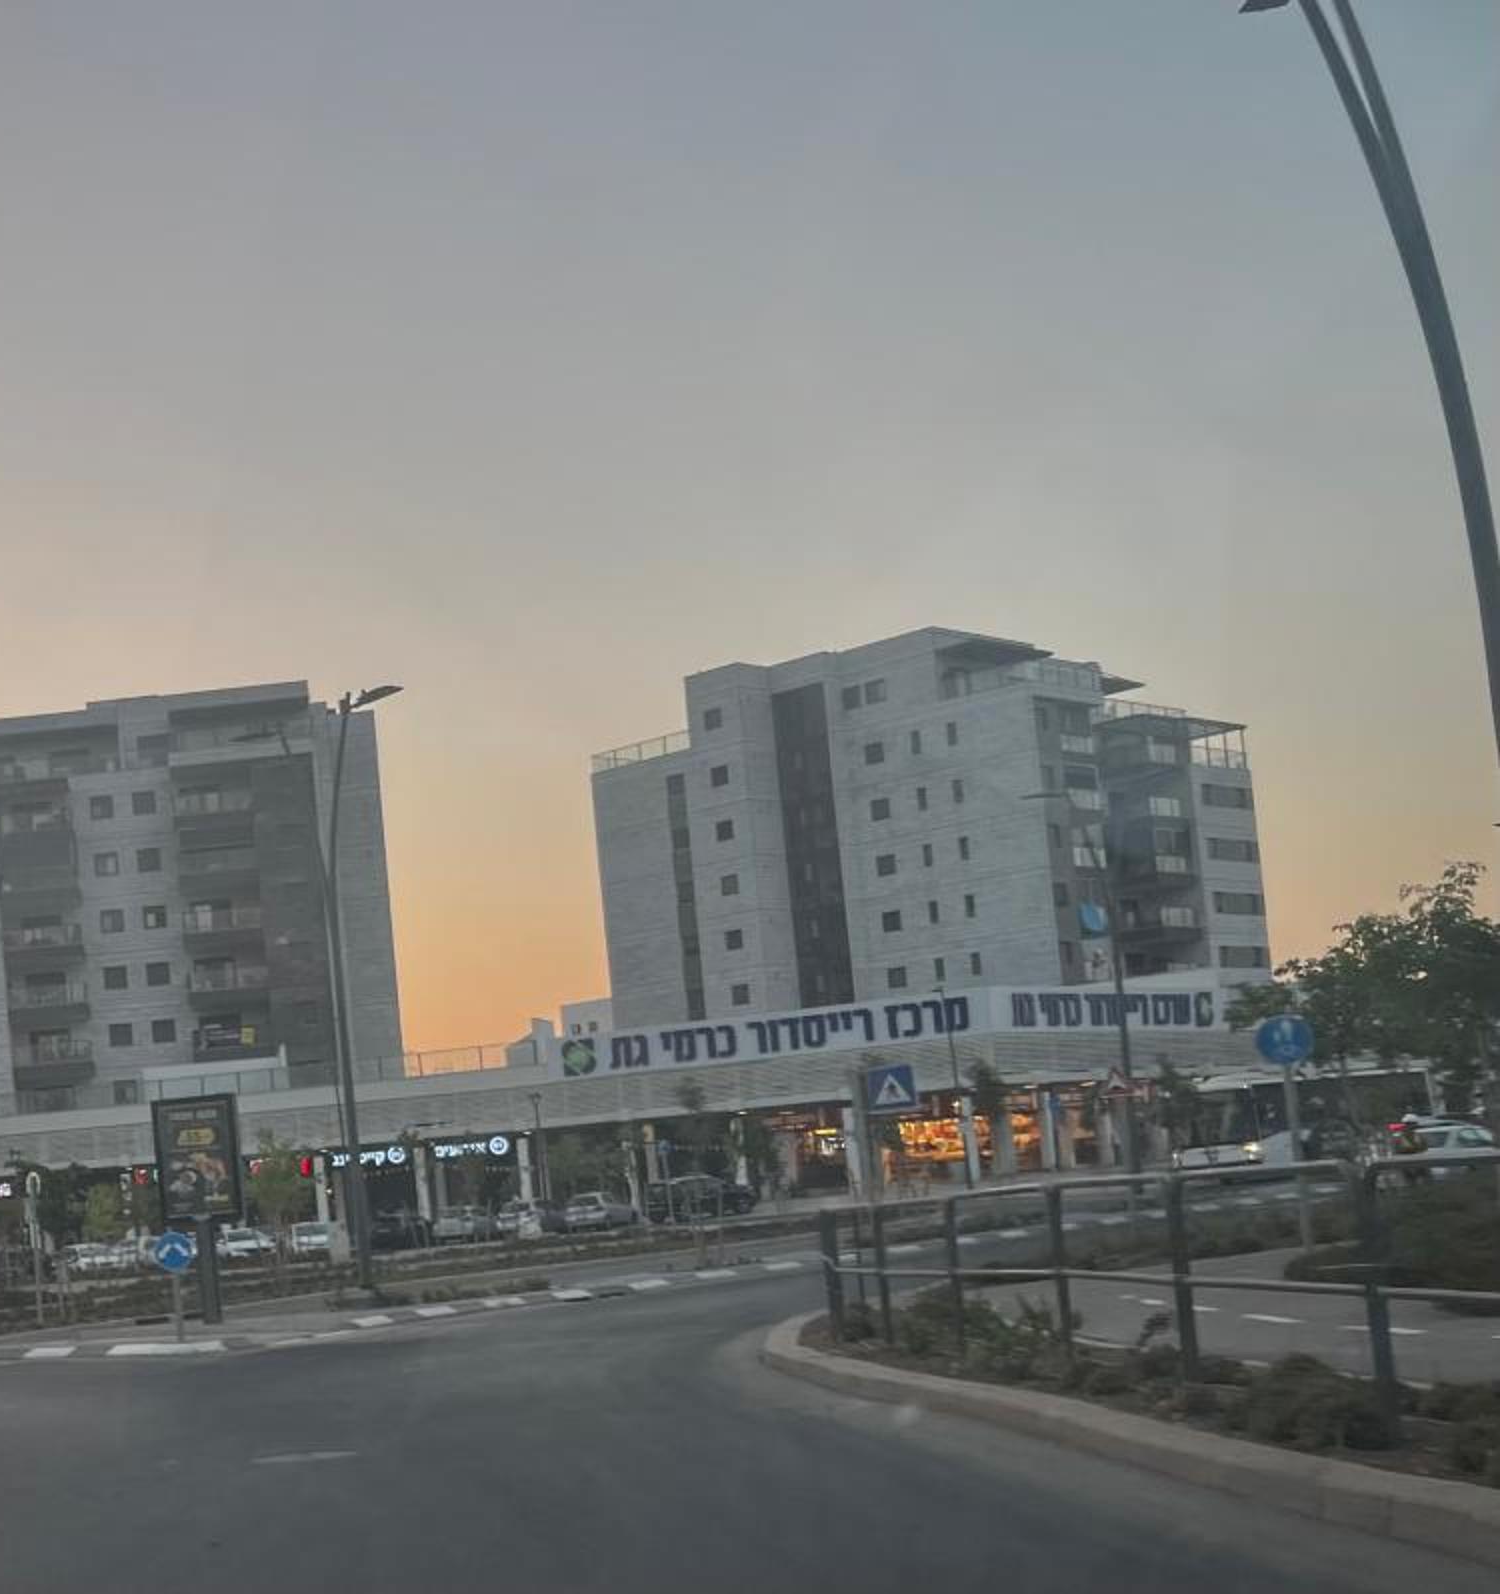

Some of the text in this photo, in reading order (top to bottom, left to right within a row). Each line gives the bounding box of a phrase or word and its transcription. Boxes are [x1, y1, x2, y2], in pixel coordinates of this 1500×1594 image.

[610, 997, 969, 1069] מרכז רייסדור כרמי גת
